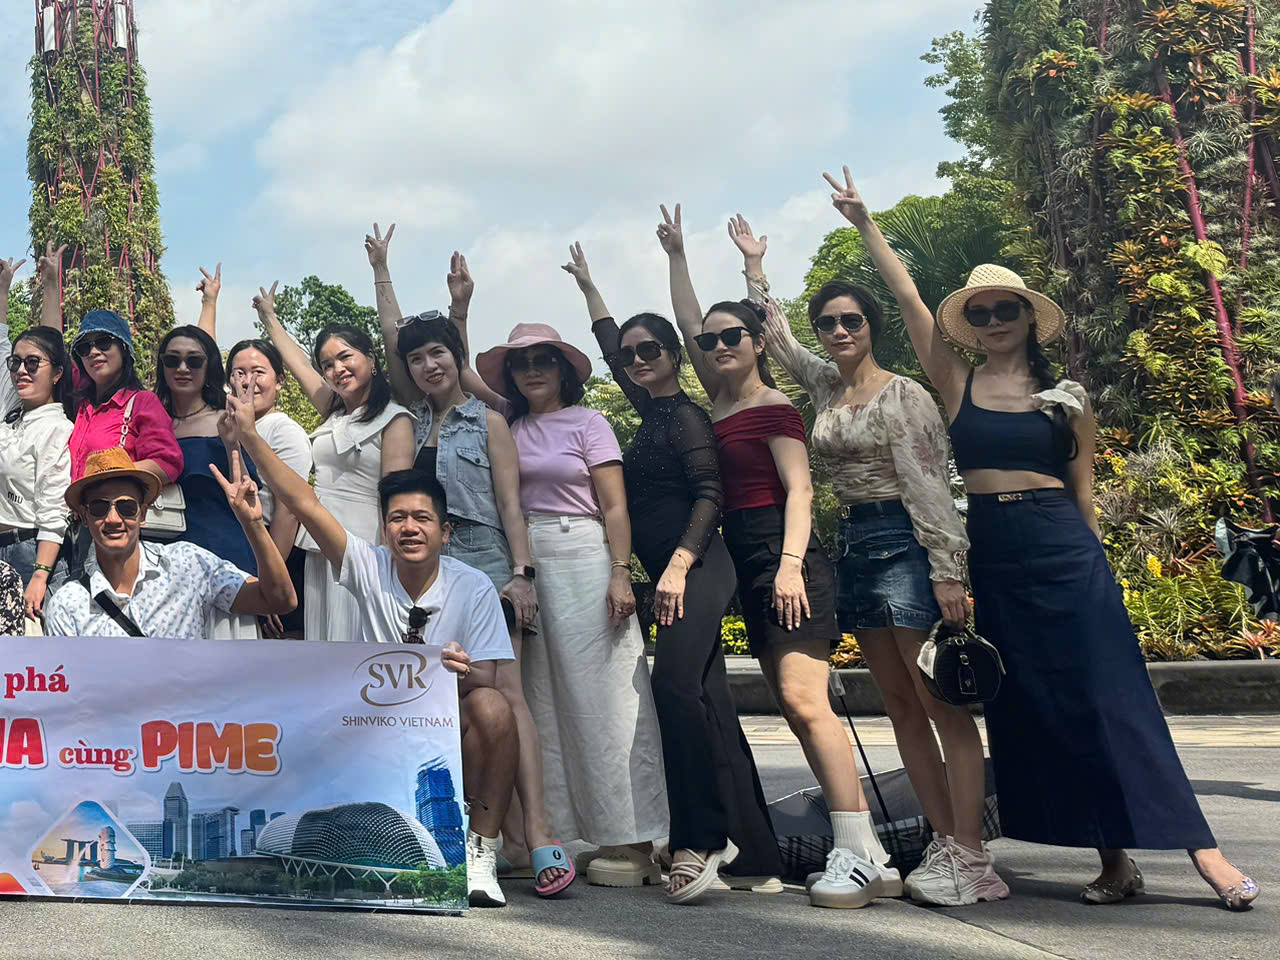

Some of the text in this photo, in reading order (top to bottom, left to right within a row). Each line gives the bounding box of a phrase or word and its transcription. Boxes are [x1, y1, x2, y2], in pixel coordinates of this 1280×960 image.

[4, 664, 70, 699] phá
[341, 715, 454, 728] SHINVIKO VIETNAM
[58, 739, 134, 772] cùng
[140, 719, 280, 773] PIME
